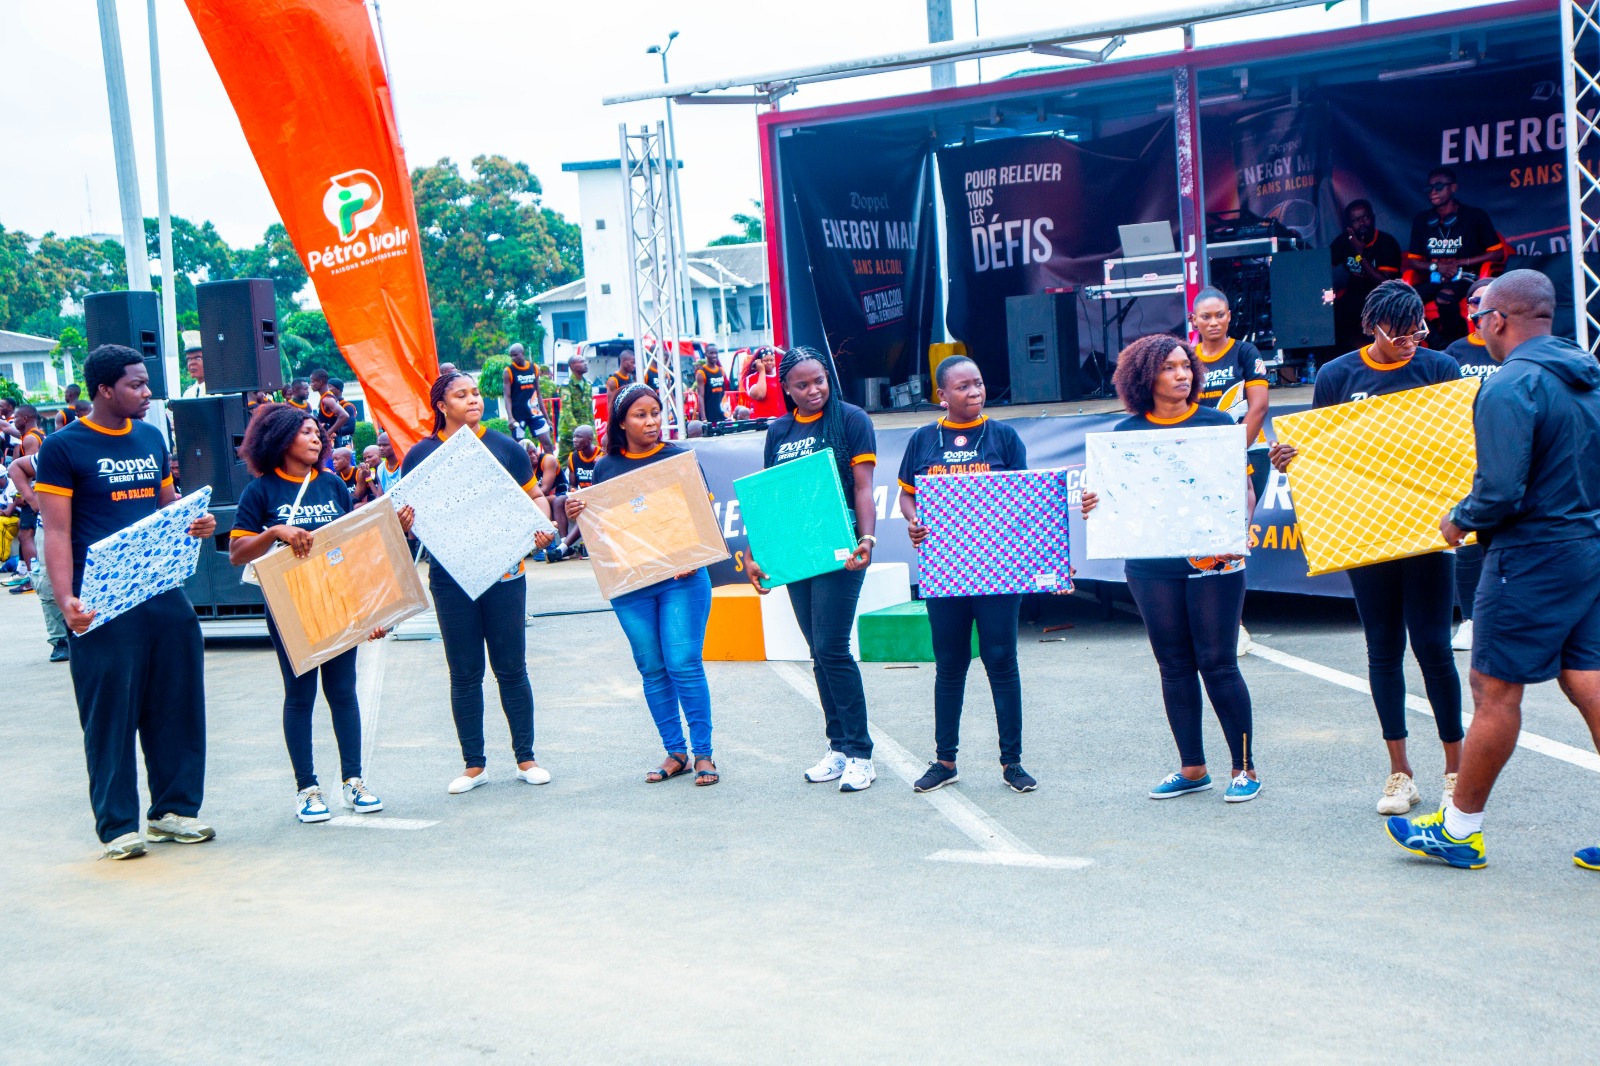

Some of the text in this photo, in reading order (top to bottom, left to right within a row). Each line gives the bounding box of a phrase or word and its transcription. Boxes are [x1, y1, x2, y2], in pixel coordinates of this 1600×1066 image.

[965, 163, 1062, 190] POUR RELEVER
[1510, 163, 1563, 188] SANS
[1257, 181, 1281, 196] SANS
[850, 192, 889, 213] Doppel
[966, 188, 993, 209] TOUS
[969, 209, 985, 226] LES
[821, 218, 880, 250] ENERGY
[971, 213, 1054, 273] DÉFIS
[1427, 236, 1462, 248] Doppel
[308, 226, 410, 273] Pétro Ivoir
[331, 262, 359, 276] FAISONS
[852, 259, 903, 275] SANS ALCOOL
[777, 436, 816, 454] Dopp
[943, 450, 978, 459] Doppel
[97, 454, 158, 474] Doppel
[109, 472, 155, 484] ENERGY MALT
[111, 487, 155, 501] 0,0% D'ALCOOL
[277, 500, 338, 518] Doppel
[287, 517, 312, 526] NERGY
[1248, 523, 1300, 550] SAN
